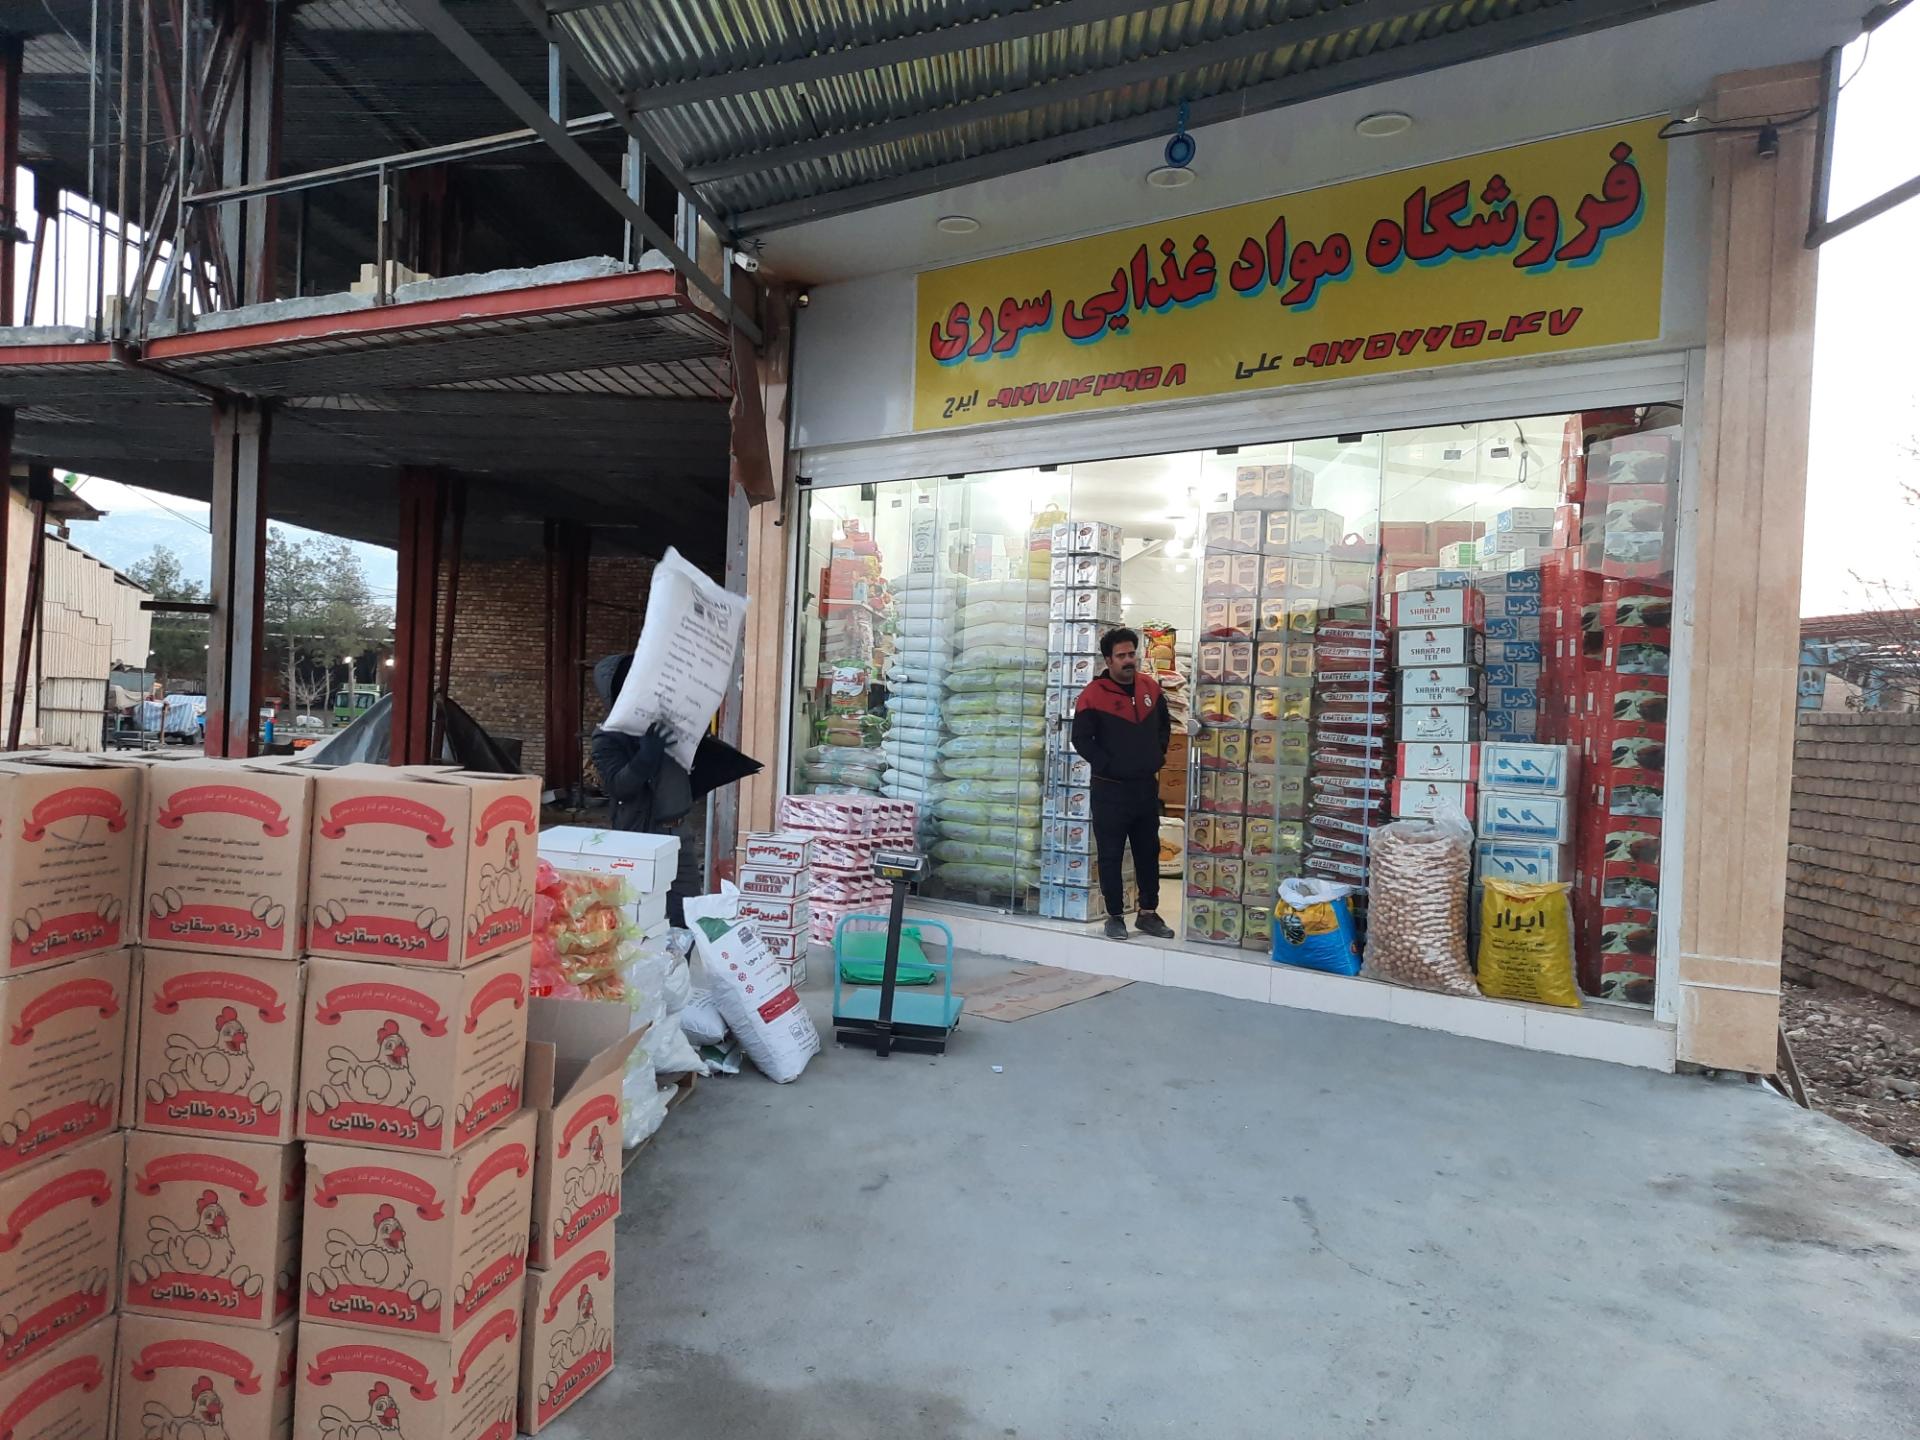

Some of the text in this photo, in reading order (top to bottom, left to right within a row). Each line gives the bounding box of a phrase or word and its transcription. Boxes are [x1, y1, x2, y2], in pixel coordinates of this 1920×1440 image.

[929, 142, 1646, 364] فروشگاه مواد غذایی سوری
[1235, 353, 1283, 379] علی
[943, 390, 978, 418] ایرج
[744, 882, 783, 894] SHIRIN
[755, 874, 790, 885] SEVAN
[170, 916, 262, 942] مزرعه سقایی
[1492, 908, 1545, 933] ابرار
[335, 925, 427, 952] مزرعه سقایی
[168, 1100, 257, 1125] زرده طلایی
[329, 1113, 419, 1139] زرده طلایی
[151, 1282, 239, 1308] زرده طلایی
[328, 1294, 417, 1322] زرده طلایی
